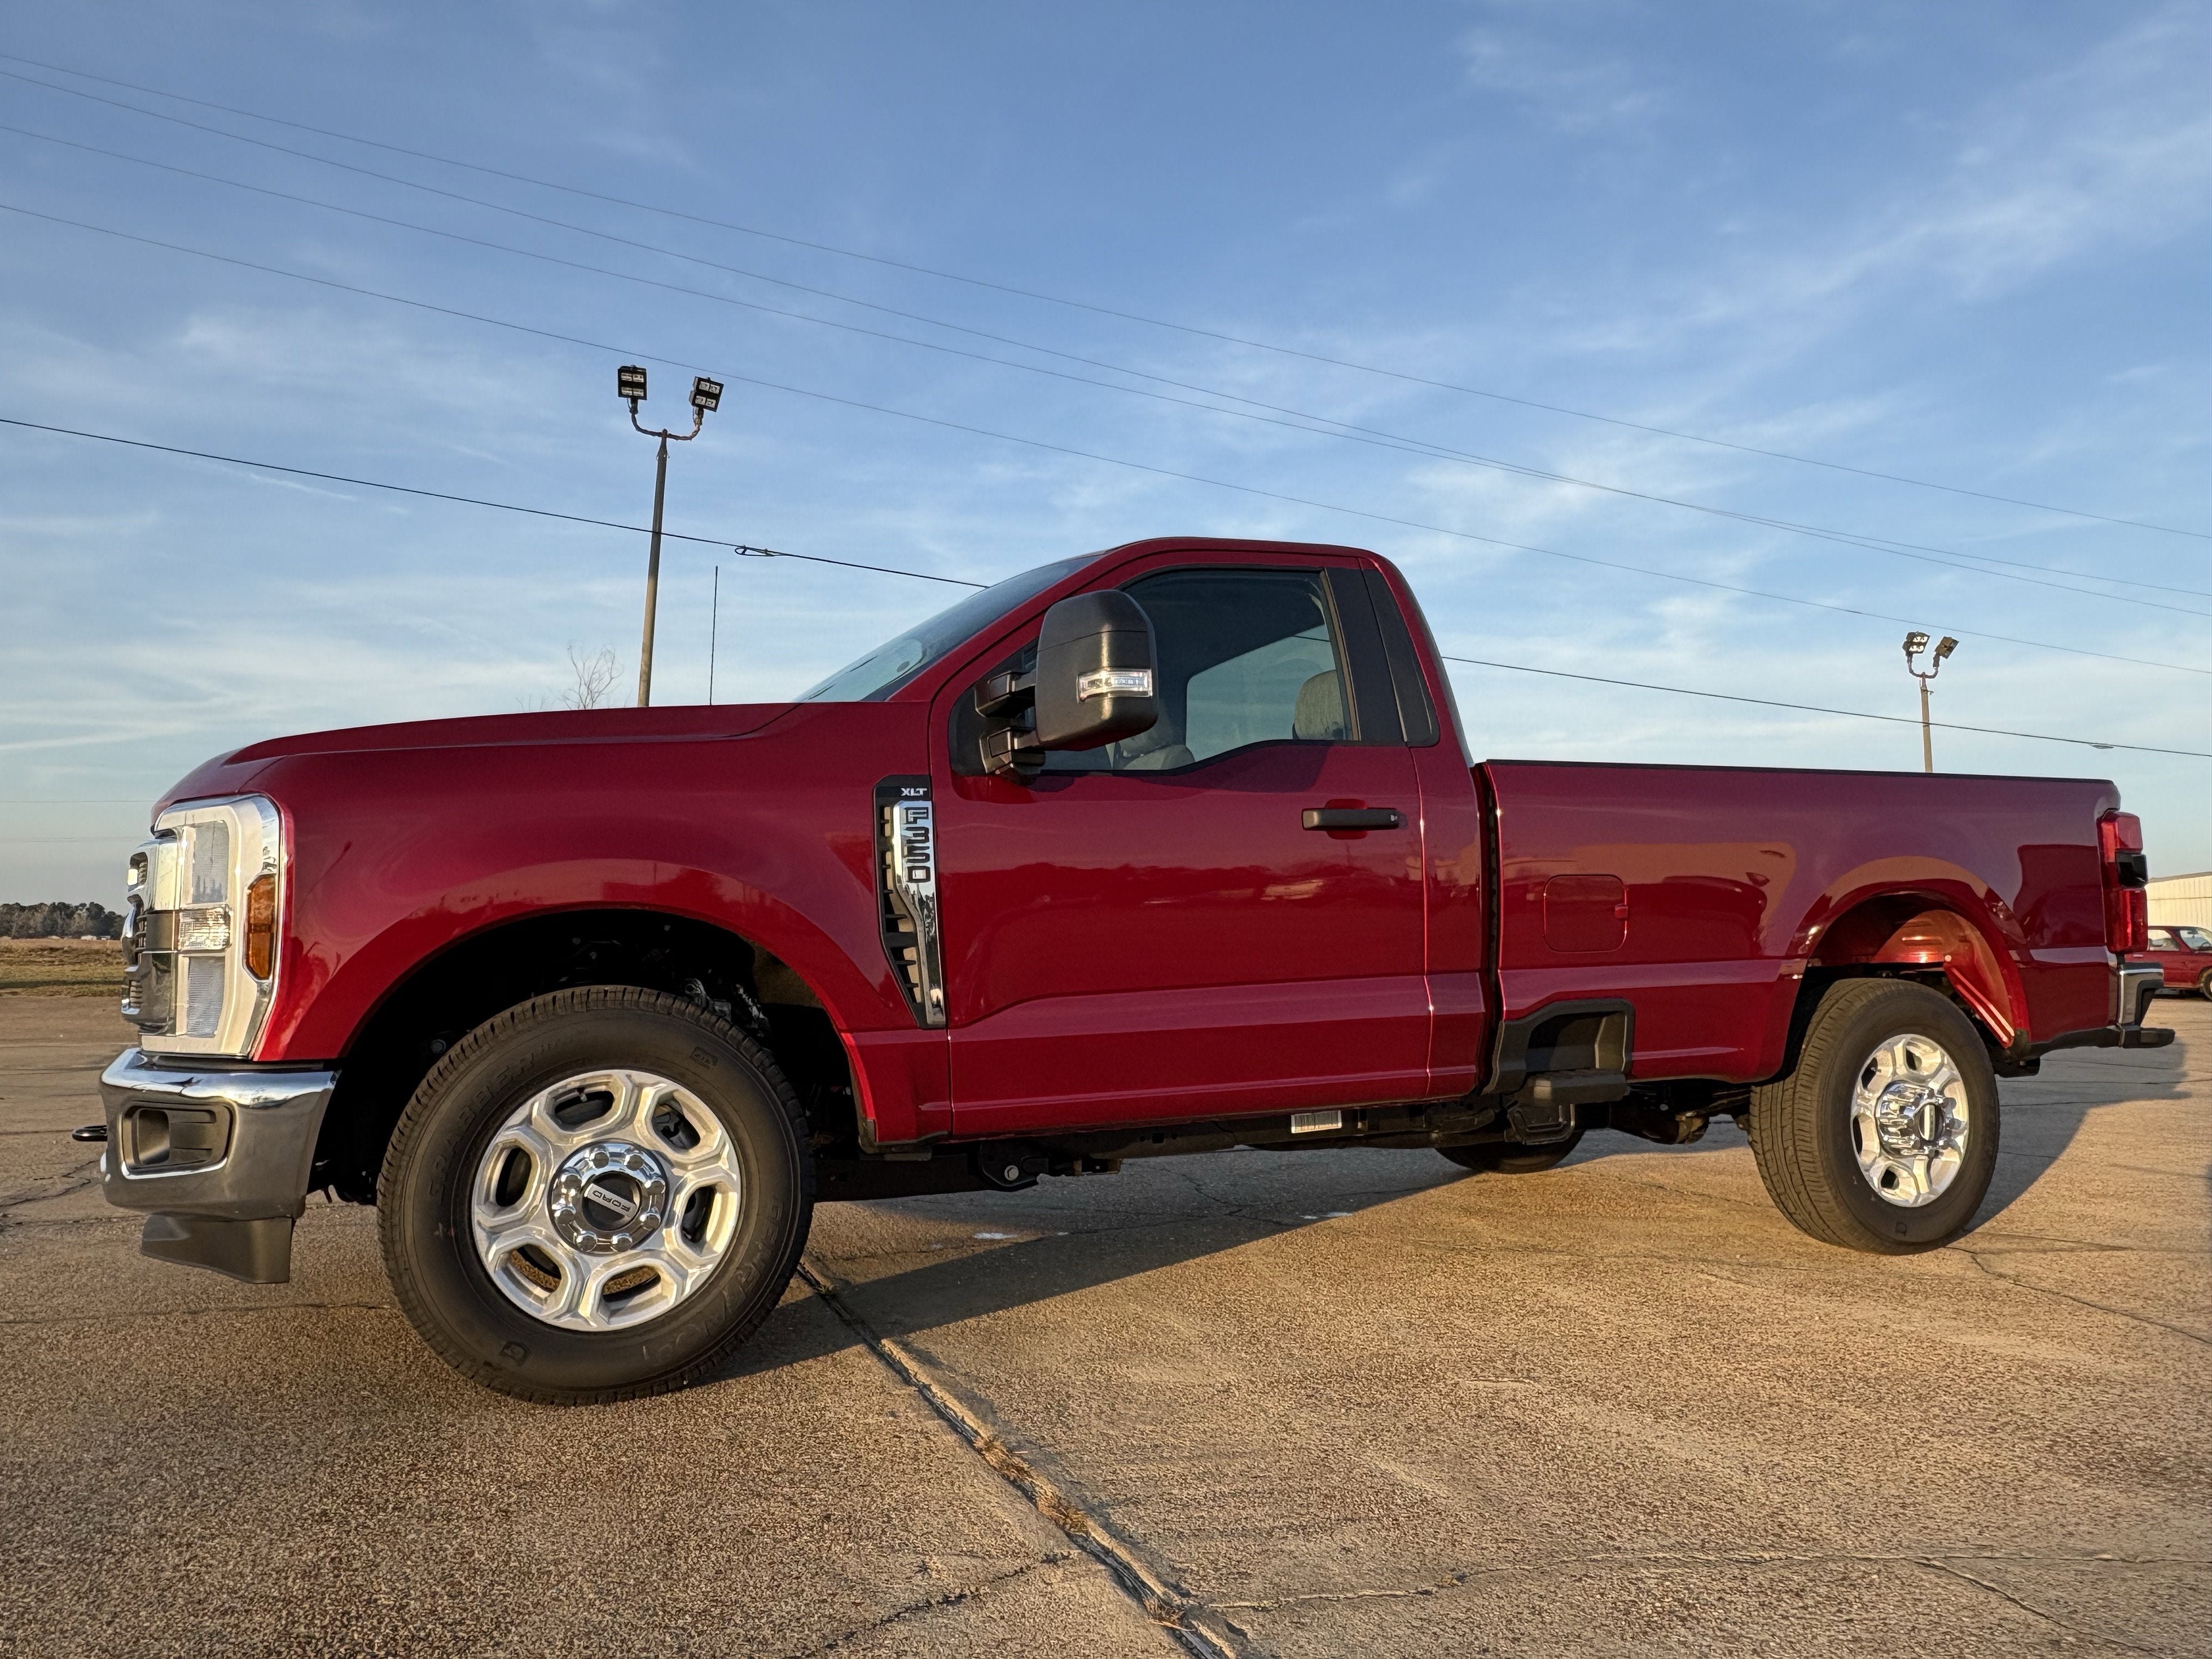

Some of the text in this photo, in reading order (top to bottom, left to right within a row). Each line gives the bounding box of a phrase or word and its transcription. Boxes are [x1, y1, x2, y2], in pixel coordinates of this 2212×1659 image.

[901, 788, 927, 796] XLT
[904, 807, 930, 883] F350
[592, 1190, 630, 1212] FORD
